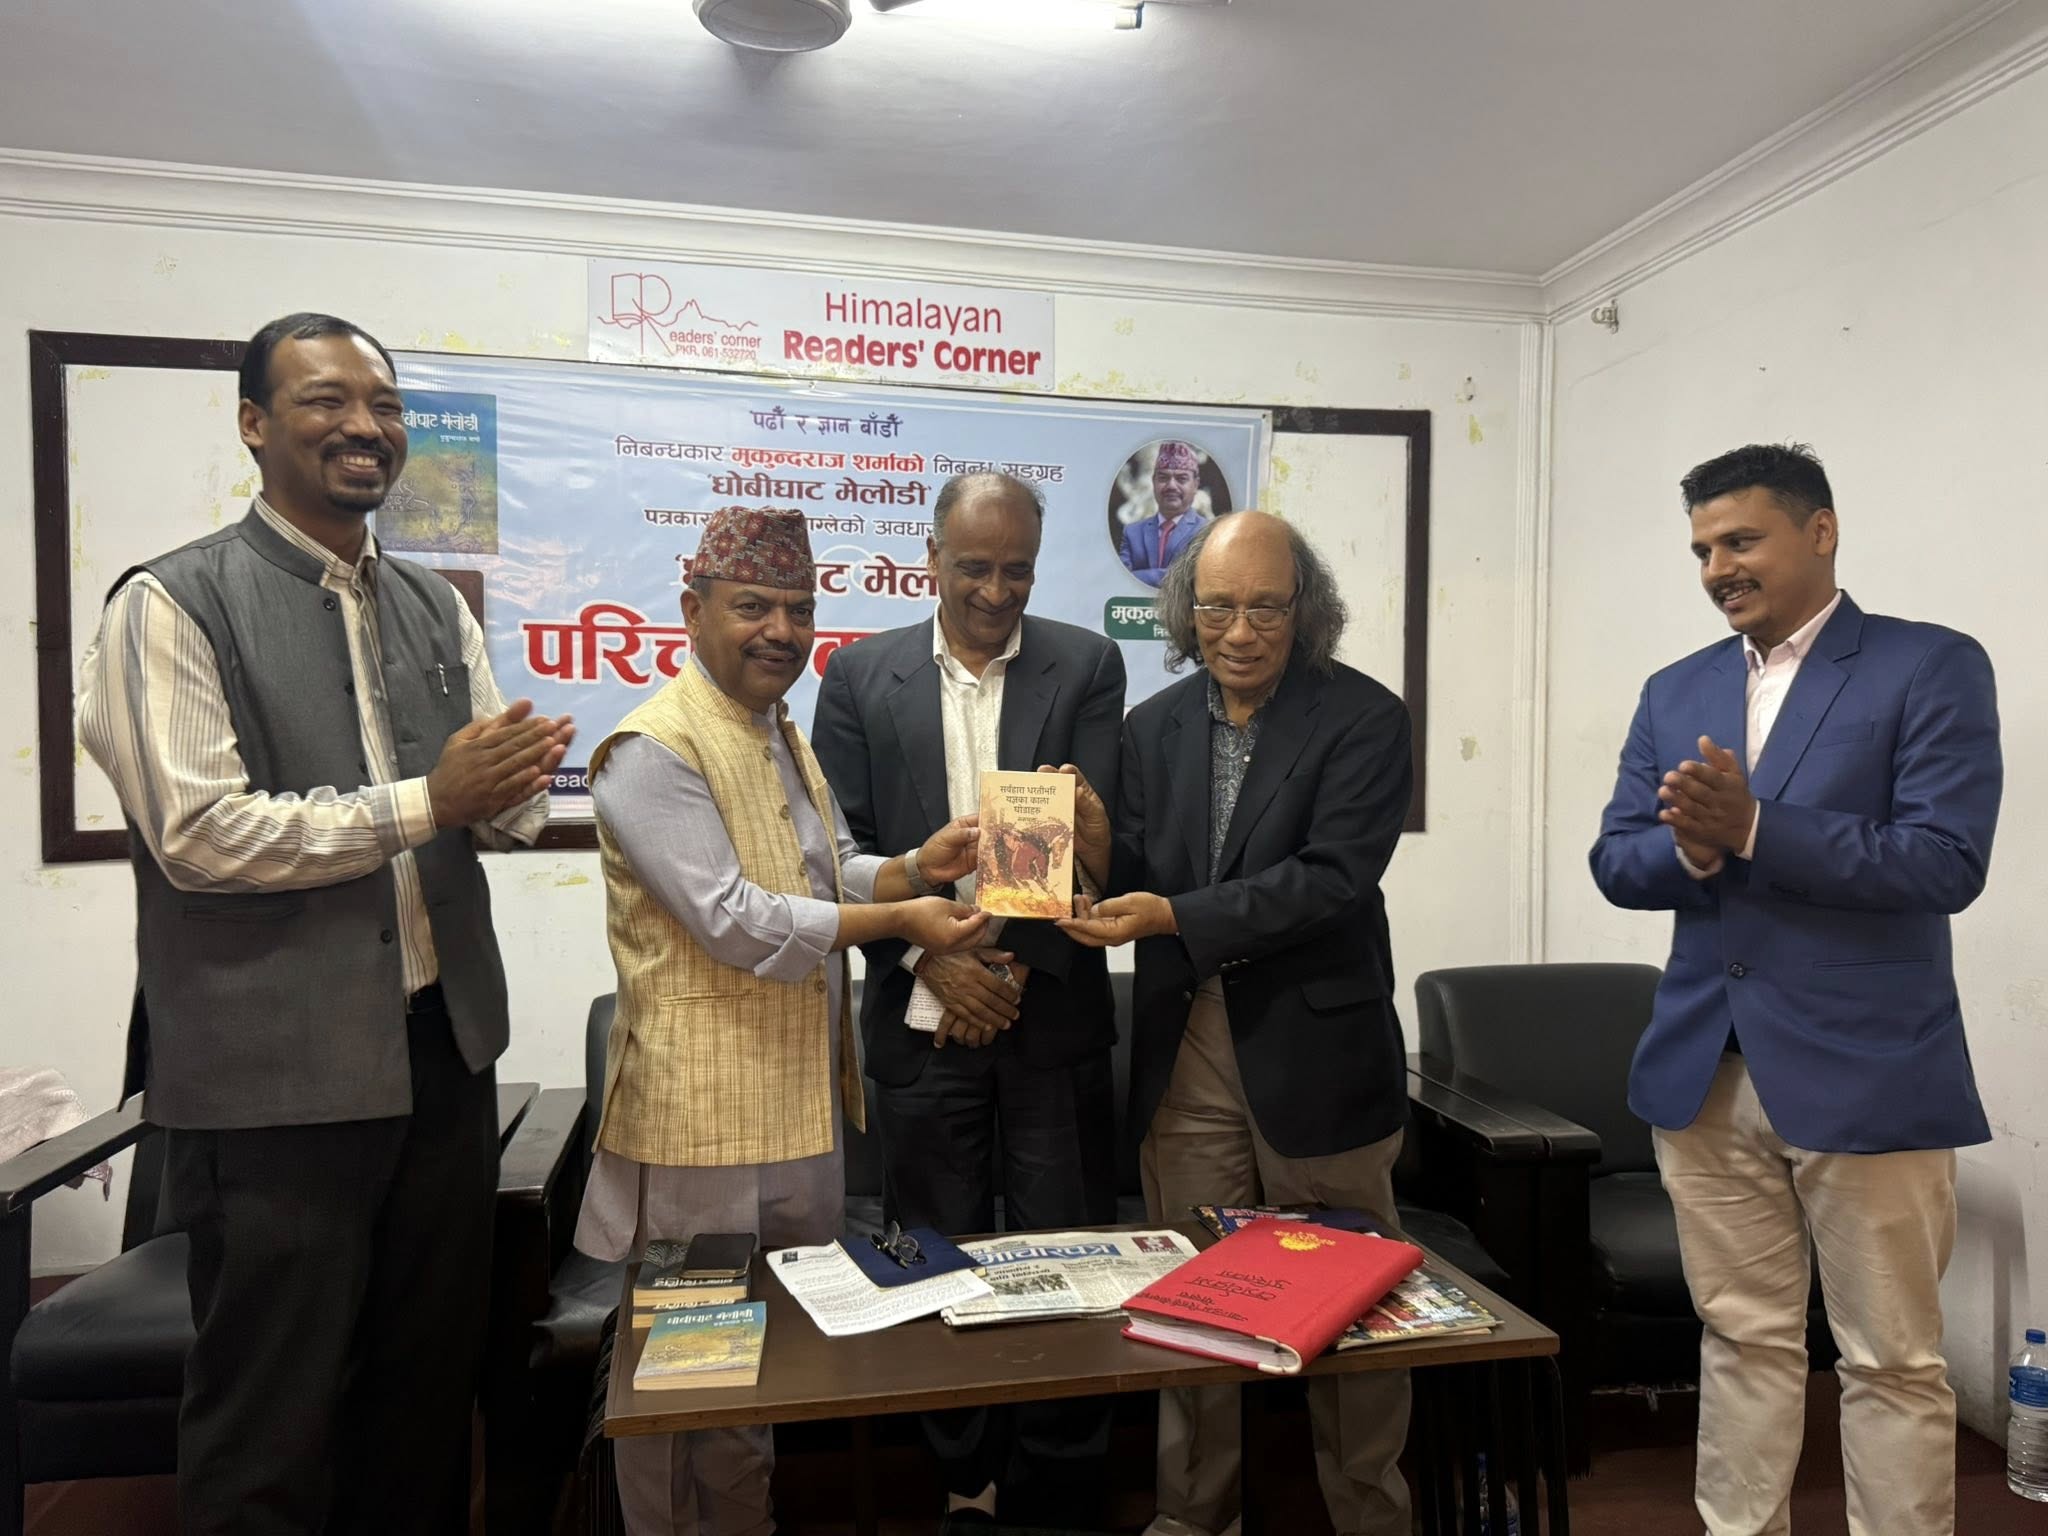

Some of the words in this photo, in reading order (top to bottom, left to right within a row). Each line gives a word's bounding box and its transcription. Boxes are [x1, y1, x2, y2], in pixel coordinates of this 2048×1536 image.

[825, 292, 1002, 336] Himalayan
[720, 334, 762, 348] corner
[702, 345, 757, 361] 061-532720
[783, 329, 925, 369] Readers'
[933, 340, 1042, 376] Corner
[402, 409, 438, 430] बीघाट
[794, 414, 811, 435] र
[817, 415, 853, 436] ज्ञान
[615, 434, 725, 464] निबन्धकार
[731, 446, 845, 471] मुकुन्दराज
[852, 452, 926, 474] शर्माको
[806, 514, 865, 535] ाग्लेको
